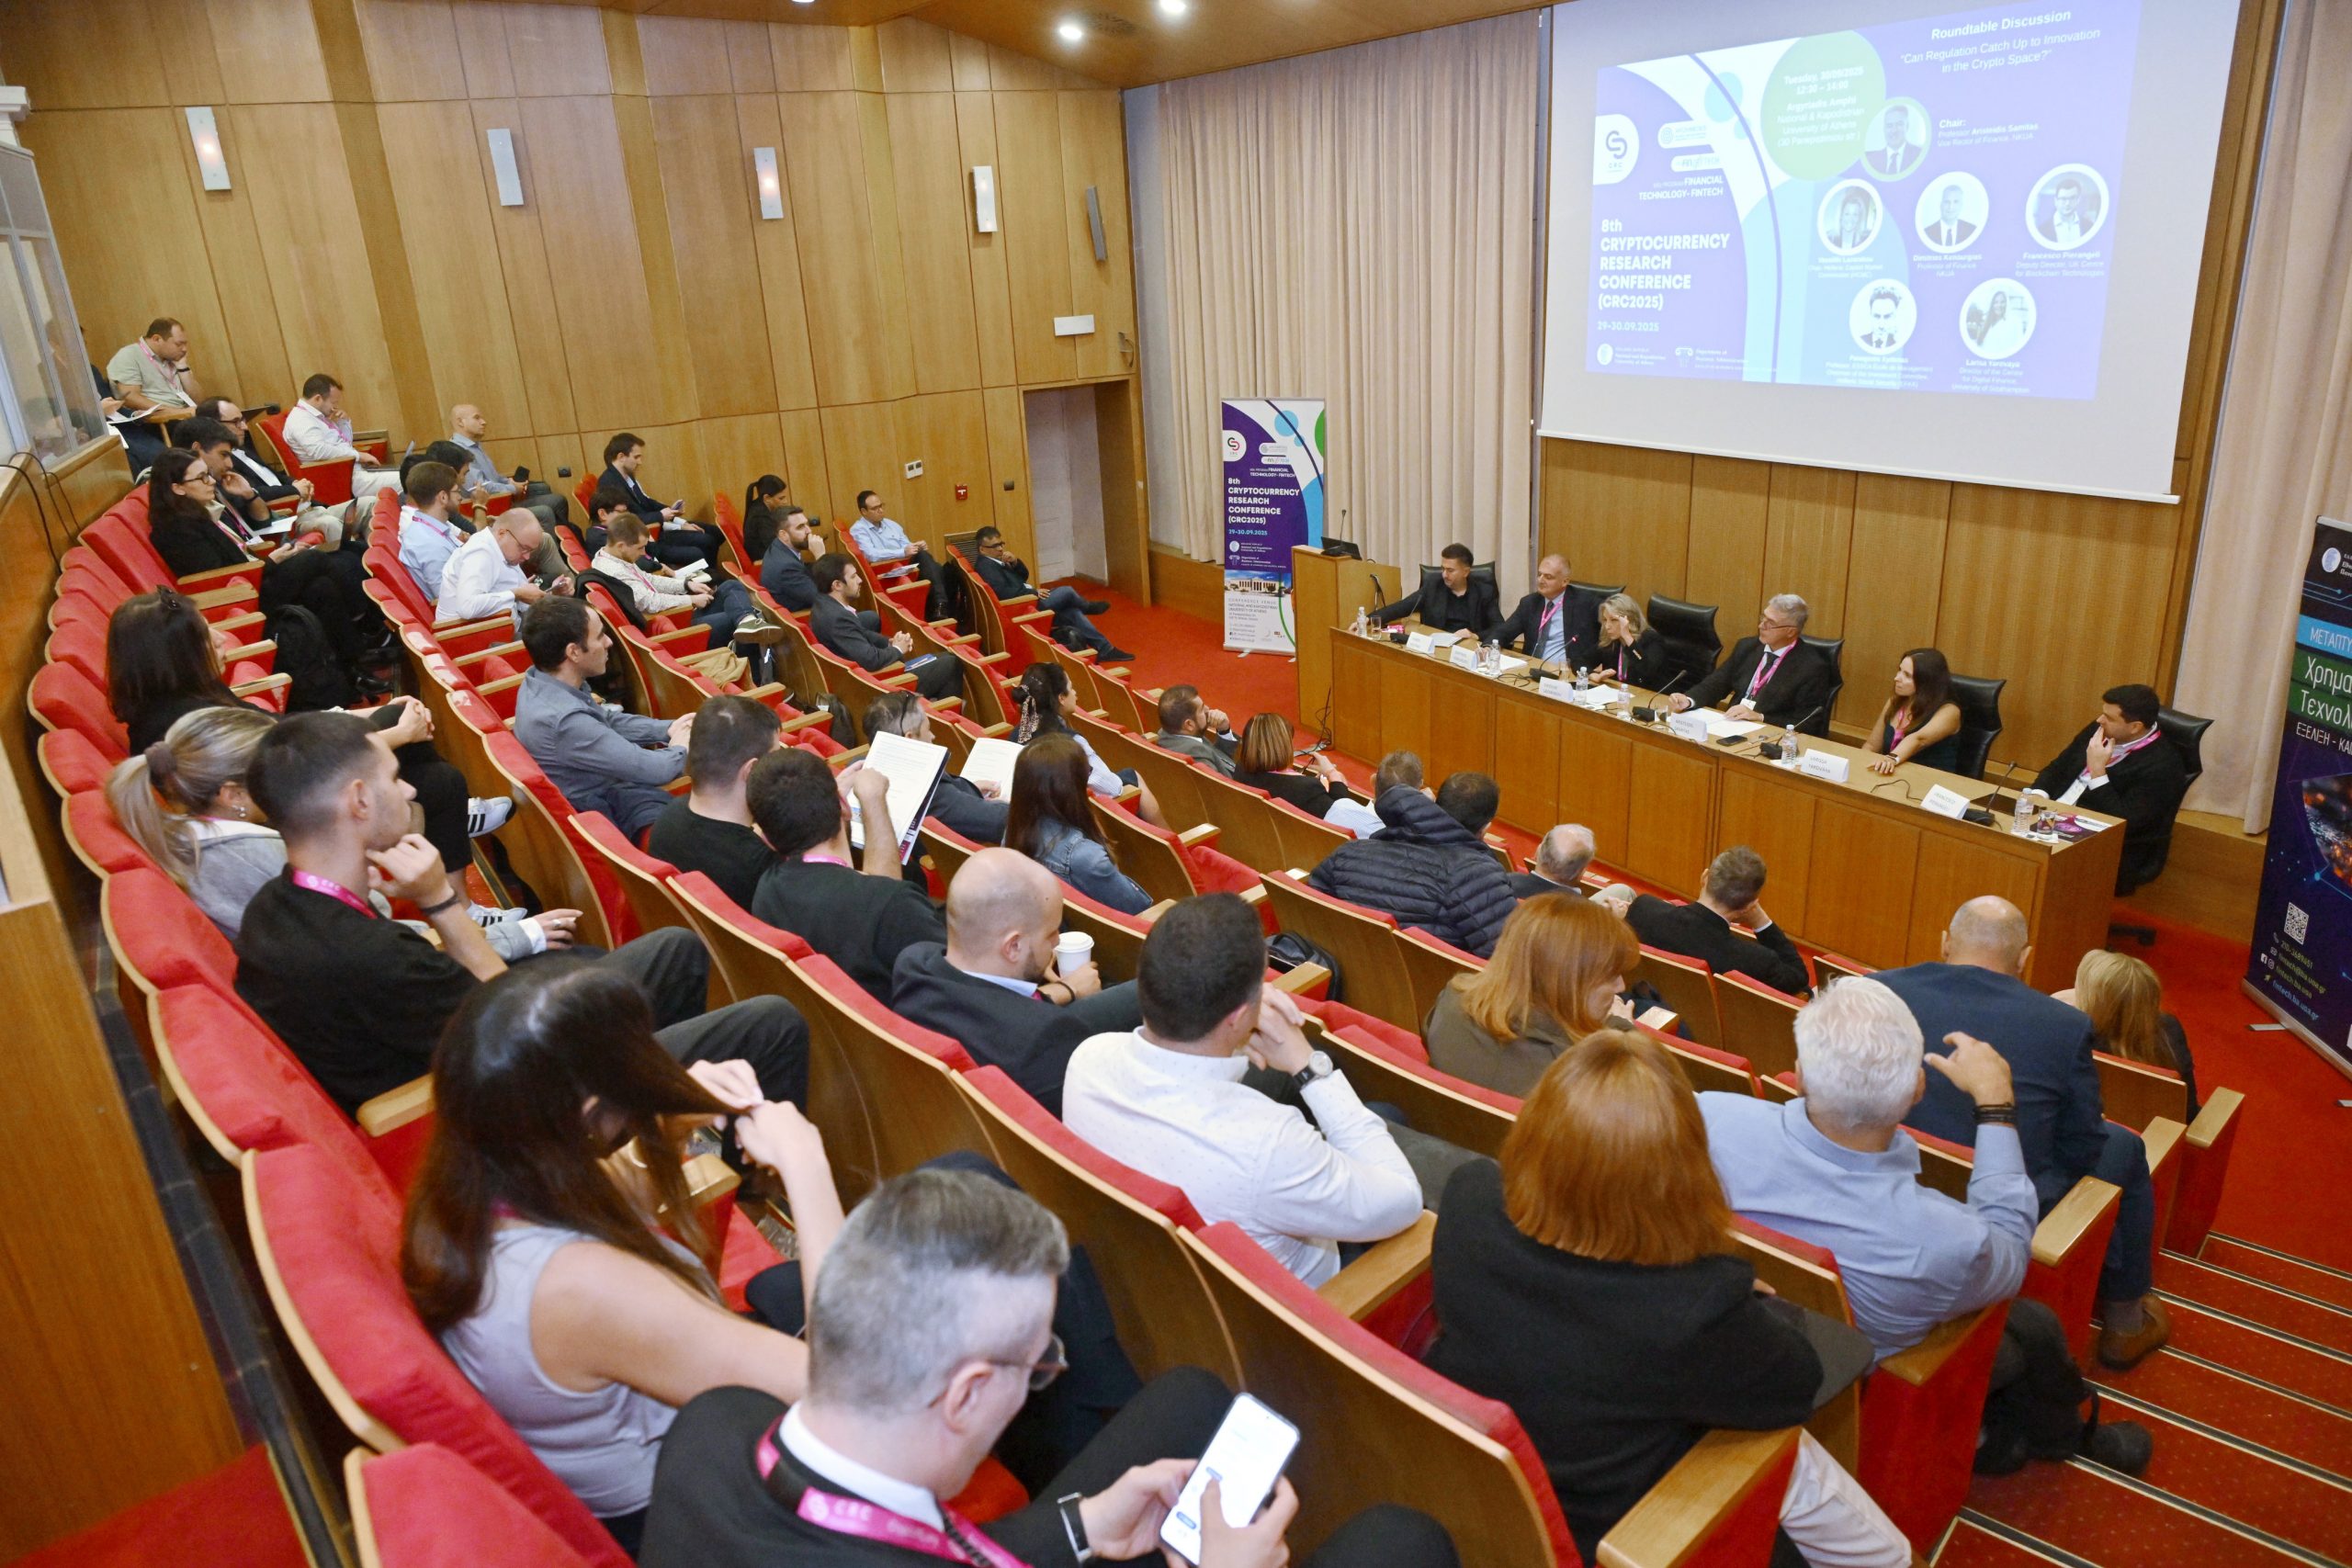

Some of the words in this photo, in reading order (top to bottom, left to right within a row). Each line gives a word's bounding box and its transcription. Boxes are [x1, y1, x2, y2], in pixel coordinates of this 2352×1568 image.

[1931, 21, 1998, 39] Roundtable
[2002, 10, 2071, 29] Discussion
[1926, 46, 1977, 62] Regulation
[1980, 42, 2009, 53] Catch
[2014, 39, 2027, 51] Up
[2030, 38, 2040, 46] to
[2043, 29, 2100, 44] Innovation
[1941, 62, 1952, 73] in
[1953, 61, 1969, 72] the
[1972, 56, 2005, 71] Crypto
[1939, 118, 1966, 129] Chair:
[1685, 175, 1724, 186] FINANCIAL
[1690, 187, 1724, 198] FINTECH
[1601, 219, 1623, 231] 8th
[1600, 233, 1729, 252] CRYPTOCURRENCY
[1600, 255, 1672, 270] RESEARCH
[1599, 274, 1690, 288] CONFERENCE
[1599, 293, 1663, 310] (CRC2025)
[1228, 487, 1299, 496] CRYPTOCURRENCY
[1228, 497, 1270, 505] RESEARCH
[1228, 506, 1282, 514] CONFERENCE
[1228, 515, 1266, 525] (CRC2025)
[2301, 689, 2352, 729] Τεχνολ
[2296, 721, 2330, 746] ΕΞΕΛΙΞΗ
